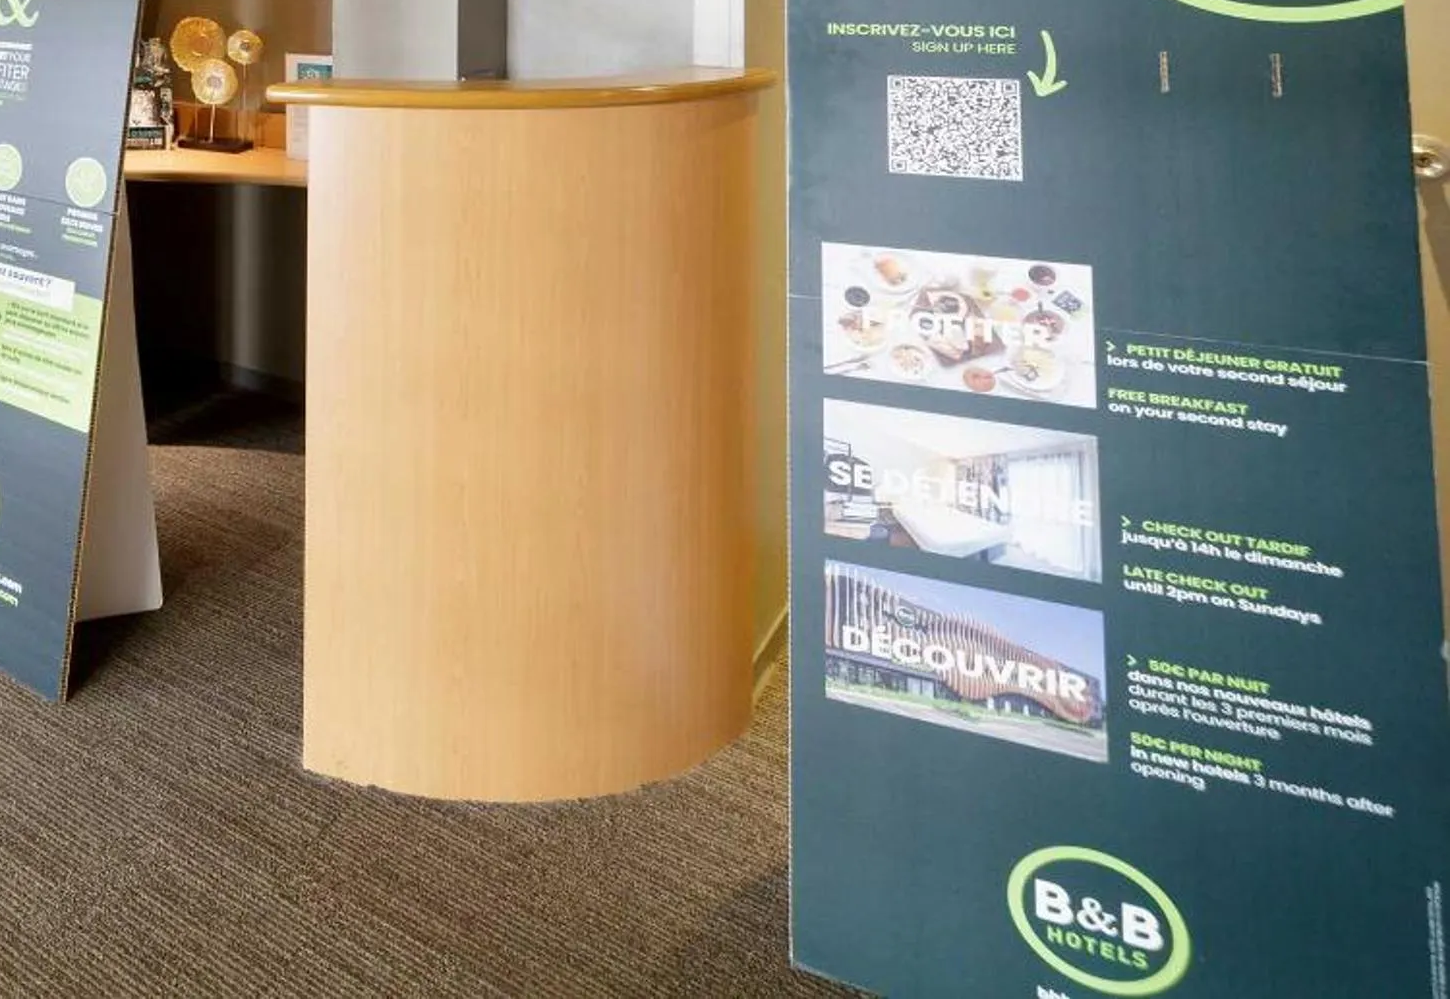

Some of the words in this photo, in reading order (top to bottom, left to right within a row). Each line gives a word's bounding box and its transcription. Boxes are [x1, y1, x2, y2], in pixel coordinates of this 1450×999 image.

[827, 22, 985, 38] INSCRIVEZ-VOUS
[989, 25, 1016, 39] ICI
[912, 41, 949, 53] SIGN
[952, 42, 974, 53] UP
[978, 43, 1017, 55] HERE
[1107, 355, 1139, 369] lors
[1141, 358, 1164, 372] de
[1167, 363, 1214, 378] votre
[1217, 368, 1285, 386] second
[1286, 374, 1348, 393] séjour
[1126, 343, 1170, 358] PETIT
[1173, 348, 1261, 370] DÉJEUNER
[1263, 359, 1343, 378] GRATUIT
[1108, 388, 1146, 402] FREE
[1149, 392, 1249, 415] BREAKFAST
[1108, 403, 1132, 414] on
[1135, 406, 1174, 421] your
[1177, 410, 1244, 429] second
[1246, 419, 1288, 437] stay
[828, 459, 872, 488] SE
[1141, 520, 1202, 540] CHECK
[1205, 530, 1243, 546] OUT
[1190, 540, 1222, 558] 14h
[1224, 546, 1243, 561] le
[1245, 550, 1344, 578] dimanche
[1124, 565, 1164, 581] LATE
[1166, 568, 1228, 594] CHECK
[1230, 583, 1270, 599] OUT
[1124, 578, 1163, 595] until
[1166, 586, 1208, 604] 2pm
[1210, 595, 1235, 609] on
[1238, 600, 1323, 625] Sundays
[842, 625, 1087, 702] DÉCOUVRIR
[1189, 667, 1225, 685] PAR
[1227, 676, 1271, 694] NUIT
[1127, 670, 1173, 689] dans
[1176, 680, 1210, 696] nos
[1213, 688, 1308, 717] nouveaux
[1310, 705, 1374, 731] hôtels
[1128, 698, 1180, 719] après
[1128, 684, 1188, 705] durant
[1191, 697, 1218, 713] les
[1221, 702, 1233, 716] 3
[1236, 708, 1320, 734] premiers
[1323, 725, 1374, 746] mois
[1169, 740, 1202, 759] PER
[1204, 749, 1263, 772] NIGHT
[1130, 761, 1207, 792] opening
[1151, 752, 1190, 771] new
[1192, 758, 1251, 785] hotels
[1253, 773, 1266, 788] 3
[1268, 778, 1344, 806] months
[1346, 796, 1396, 819] after
[1034, 878, 1165, 952] B&B
[1046, 927, 1150, 970] HOTELS
